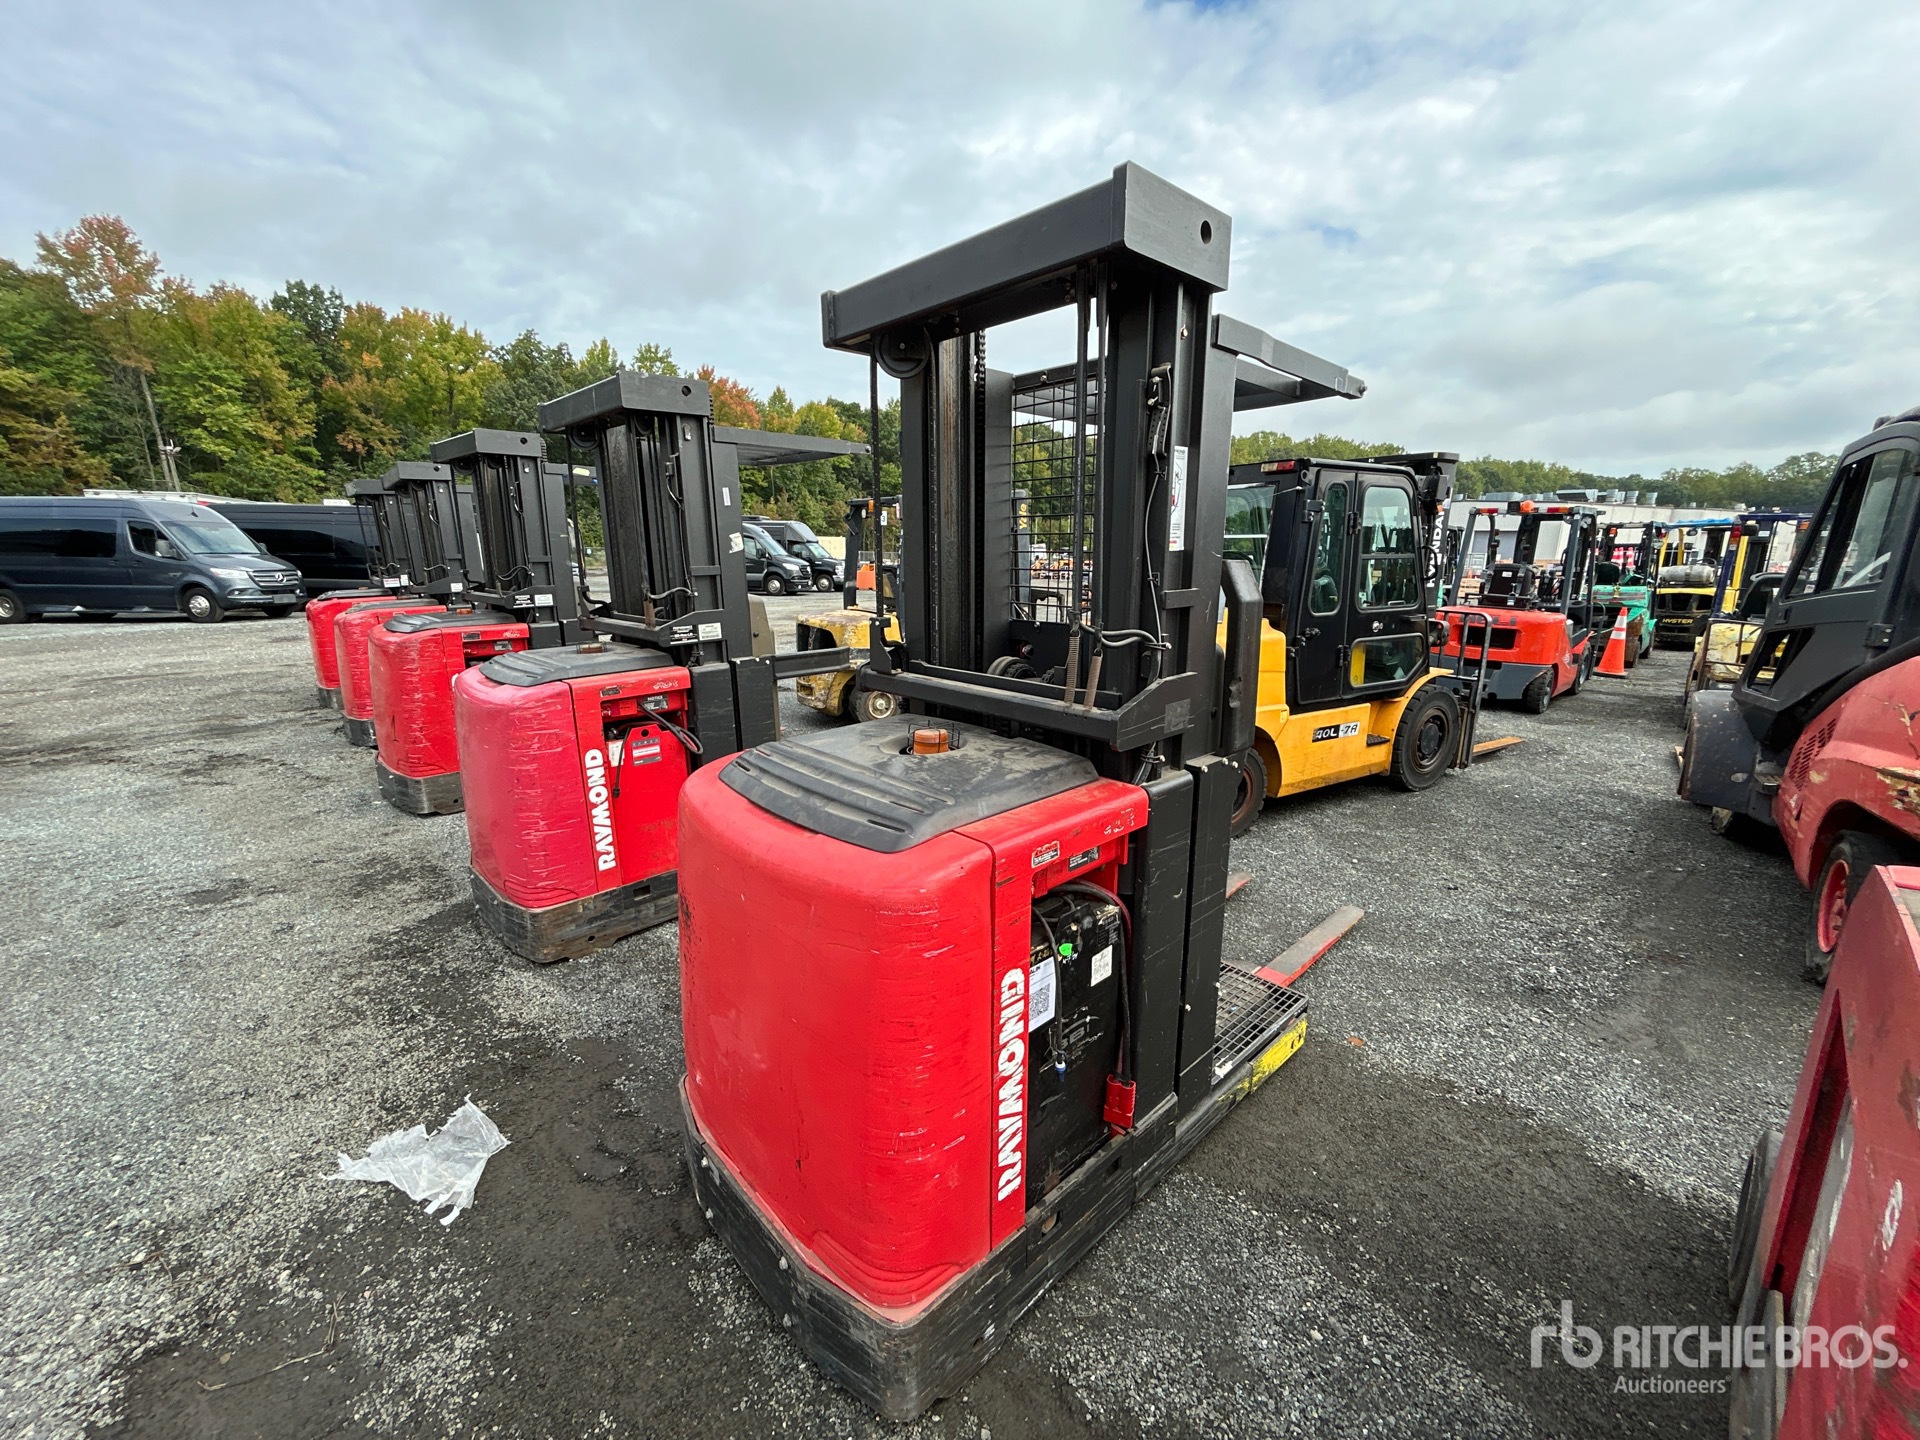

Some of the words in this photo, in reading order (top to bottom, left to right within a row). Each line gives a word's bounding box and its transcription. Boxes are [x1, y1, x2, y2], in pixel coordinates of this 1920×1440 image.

[1019, 503, 1027, 530] Yale
[585, 748, 617, 871] RAYMOND
[998, 967, 1025, 1202] RAYMOND
